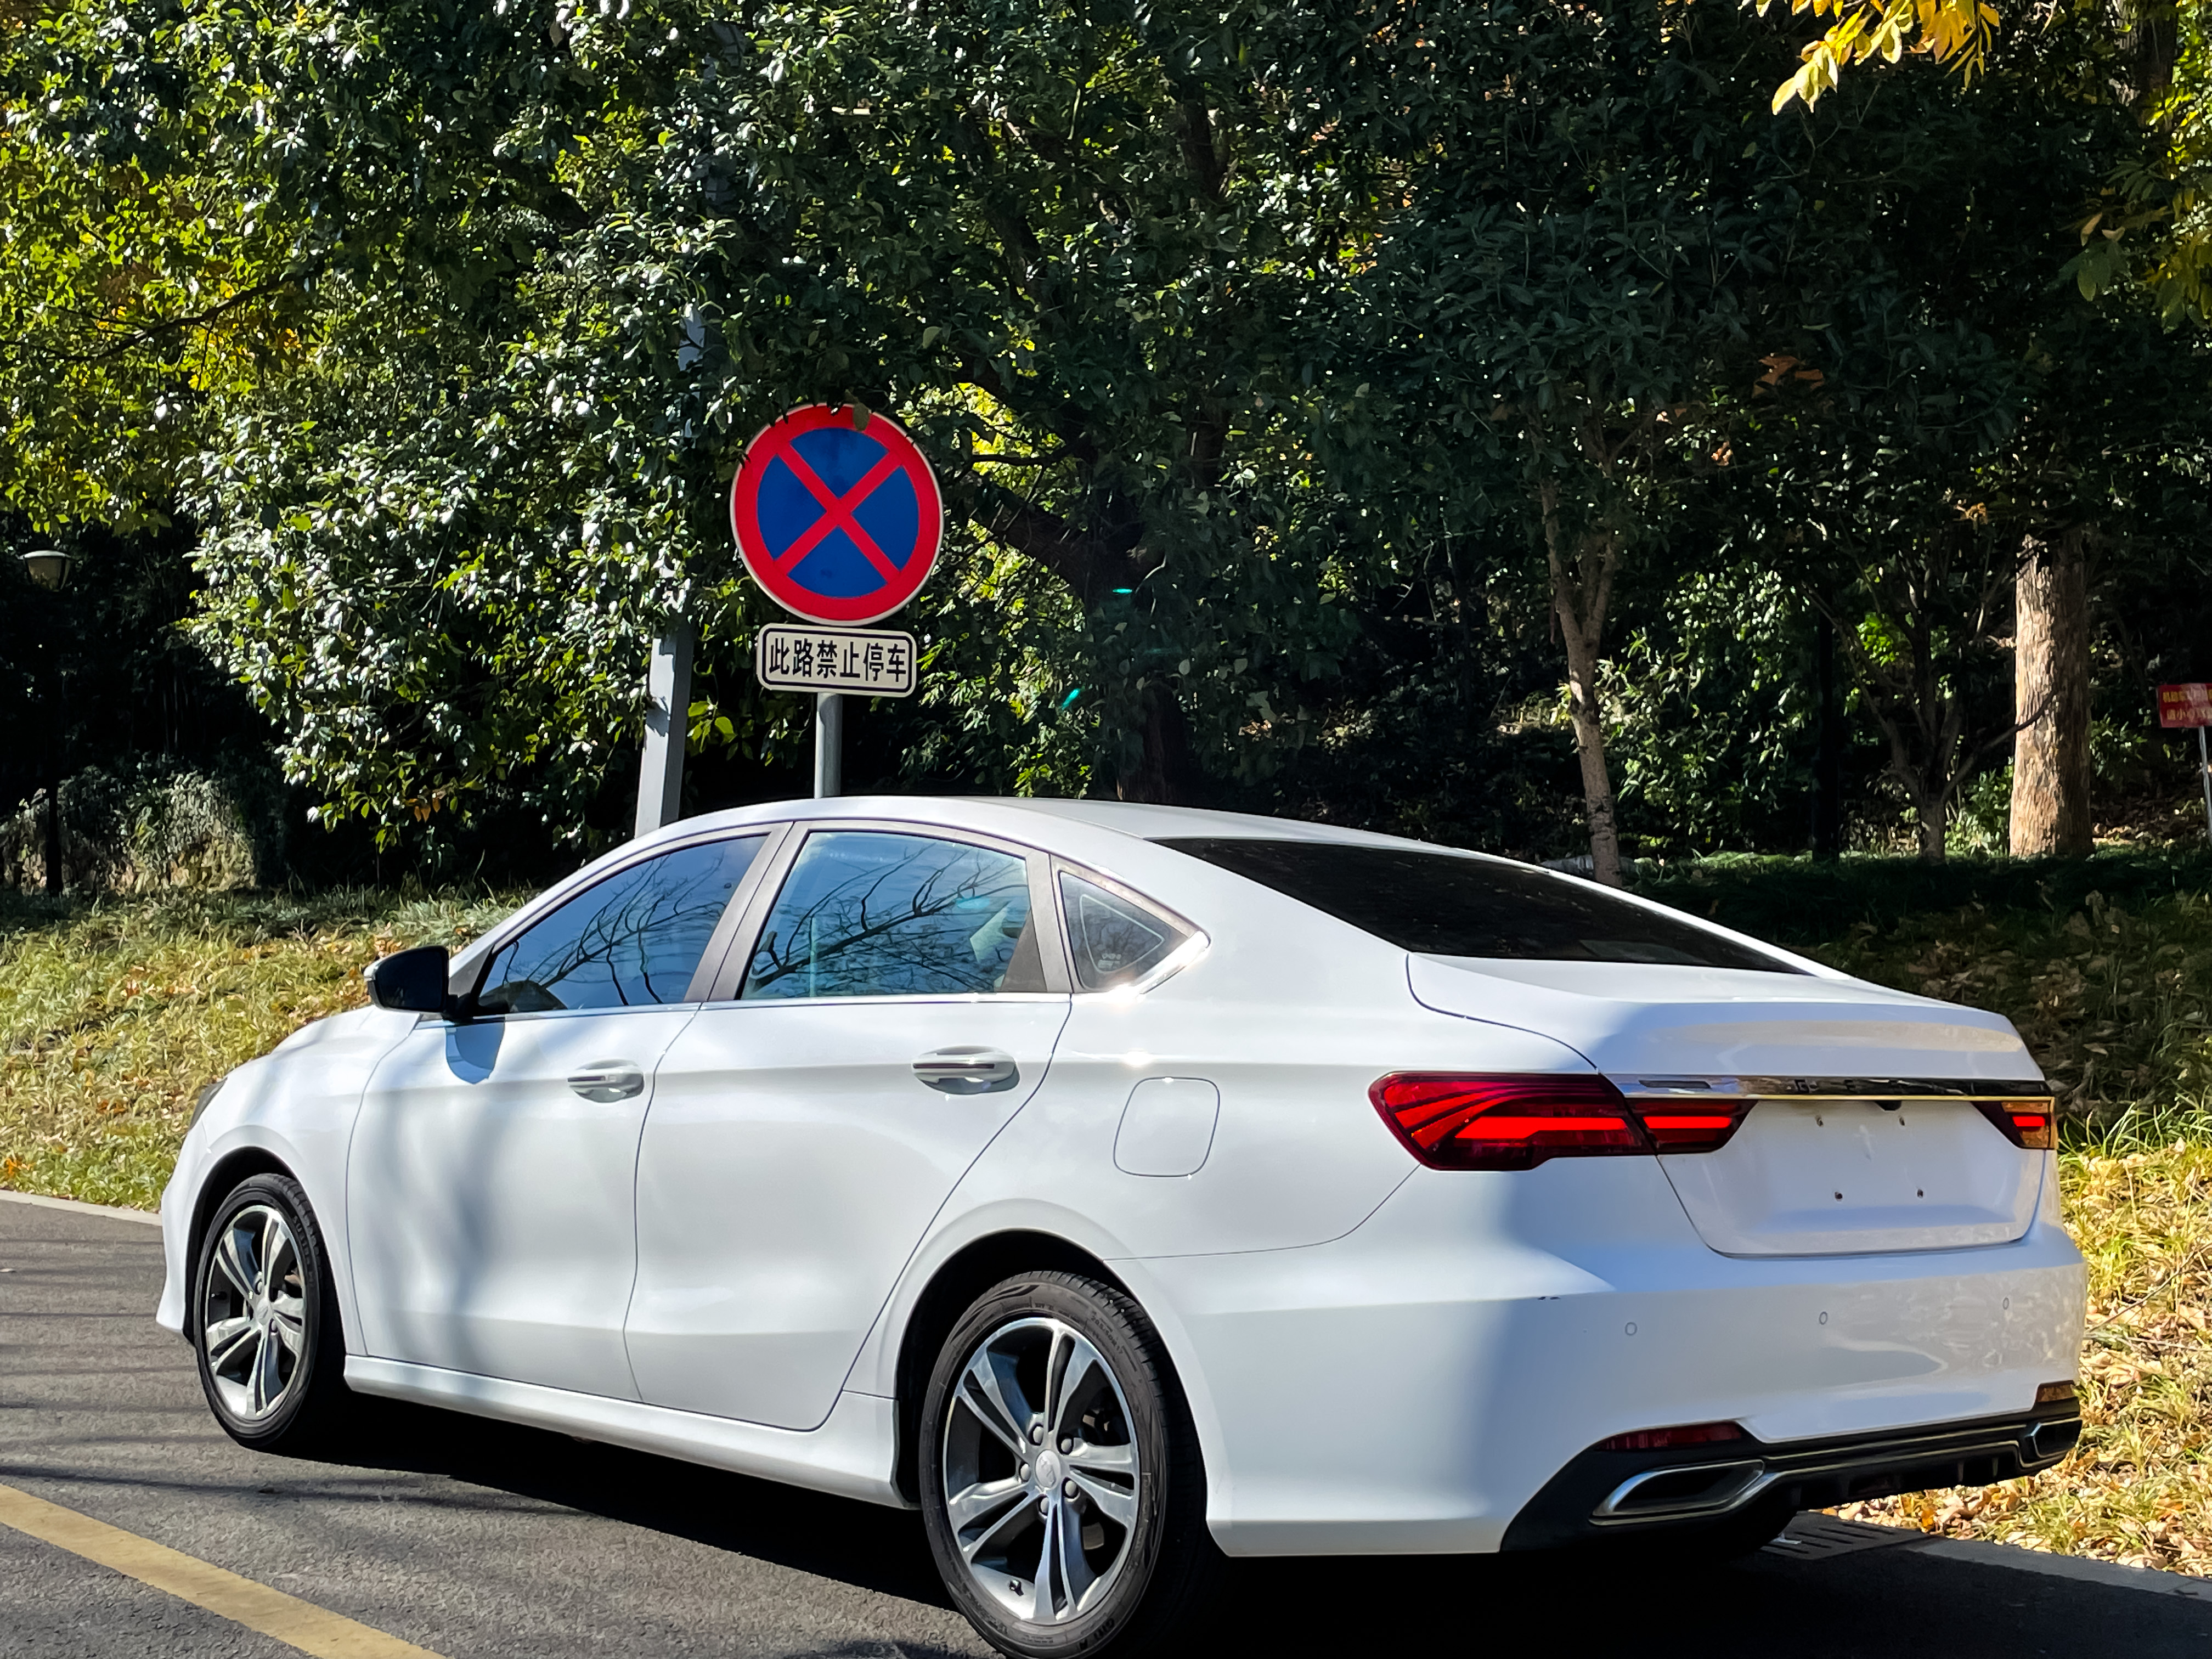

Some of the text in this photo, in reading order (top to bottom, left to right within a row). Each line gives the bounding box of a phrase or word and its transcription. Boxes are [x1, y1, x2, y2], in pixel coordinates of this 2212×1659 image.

[769, 637, 906, 682] 此路禁止停车
